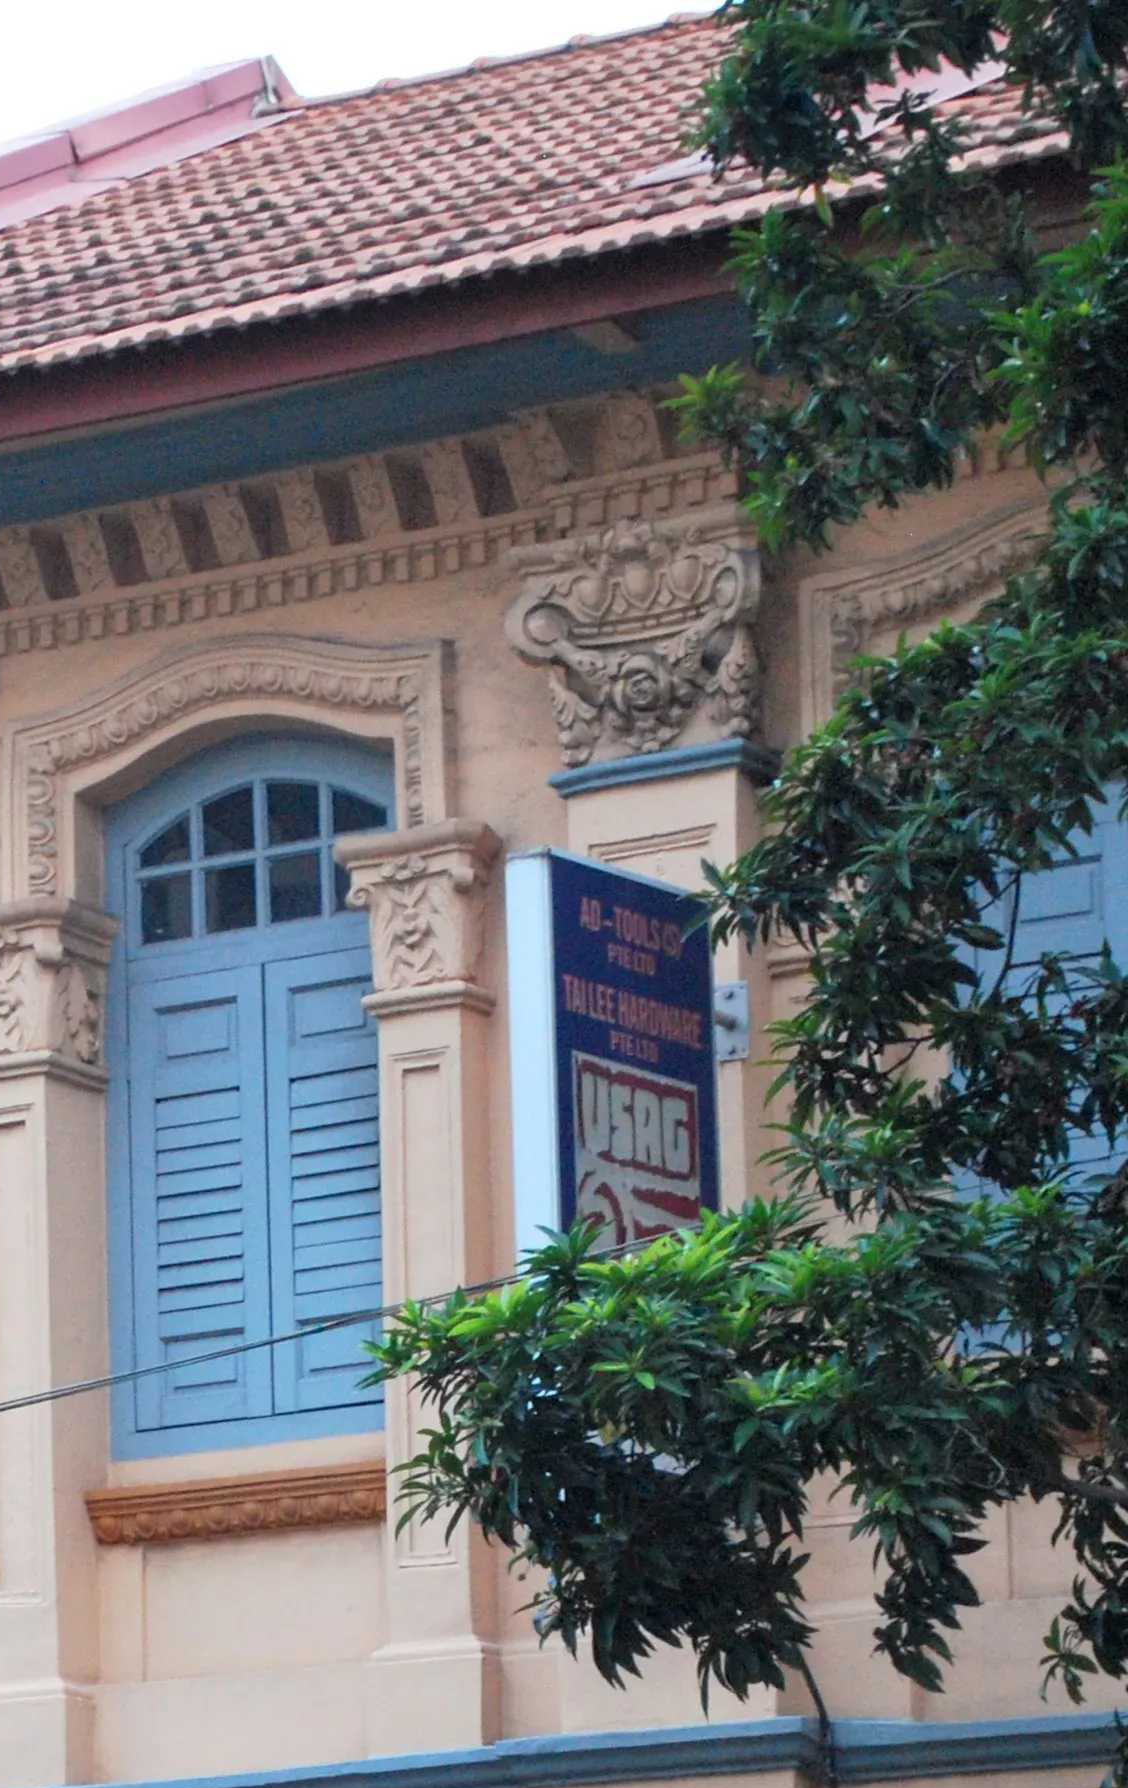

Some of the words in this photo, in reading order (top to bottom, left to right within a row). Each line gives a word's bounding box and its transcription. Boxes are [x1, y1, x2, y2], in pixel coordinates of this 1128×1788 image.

[607, 942, 632, 968] PTE
[634, 951, 656, 977] LTD
[618, 990, 703, 1051] HARDWARE
[610, 1029, 634, 1056] PTE
[636, 1037, 660, 1063] LTD
[578, 1068, 691, 1175] USAG
